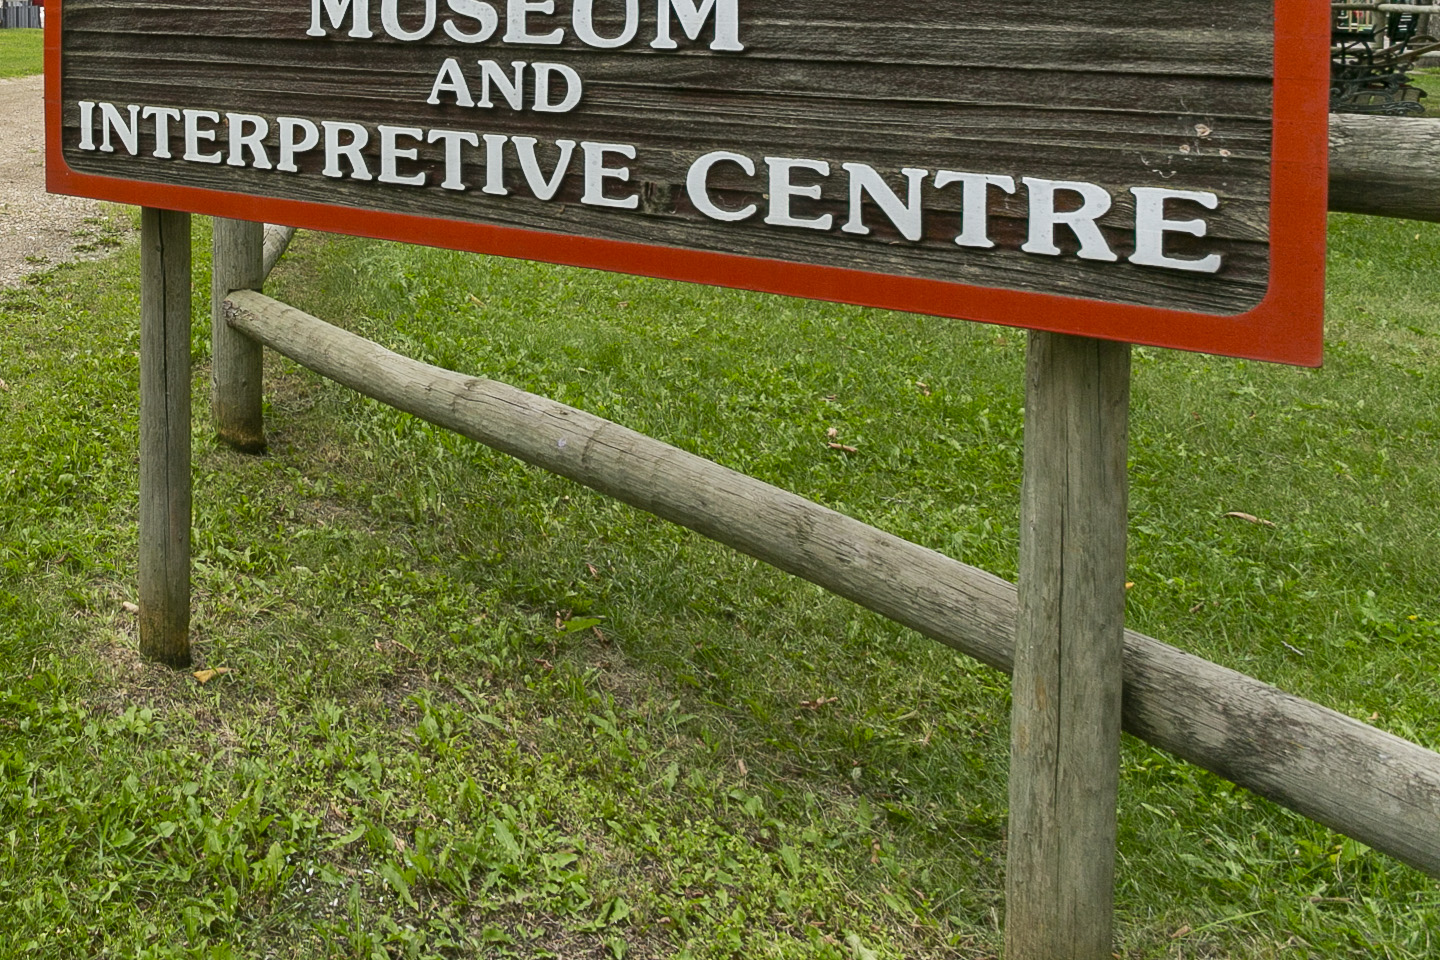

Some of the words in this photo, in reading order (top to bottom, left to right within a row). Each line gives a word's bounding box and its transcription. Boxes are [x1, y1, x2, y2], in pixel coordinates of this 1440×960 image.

[426, 57, 583, 113] AND
[78, 100, 639, 210] INTERPRETIVE
[685, 150, 1223, 274] CENTRE
